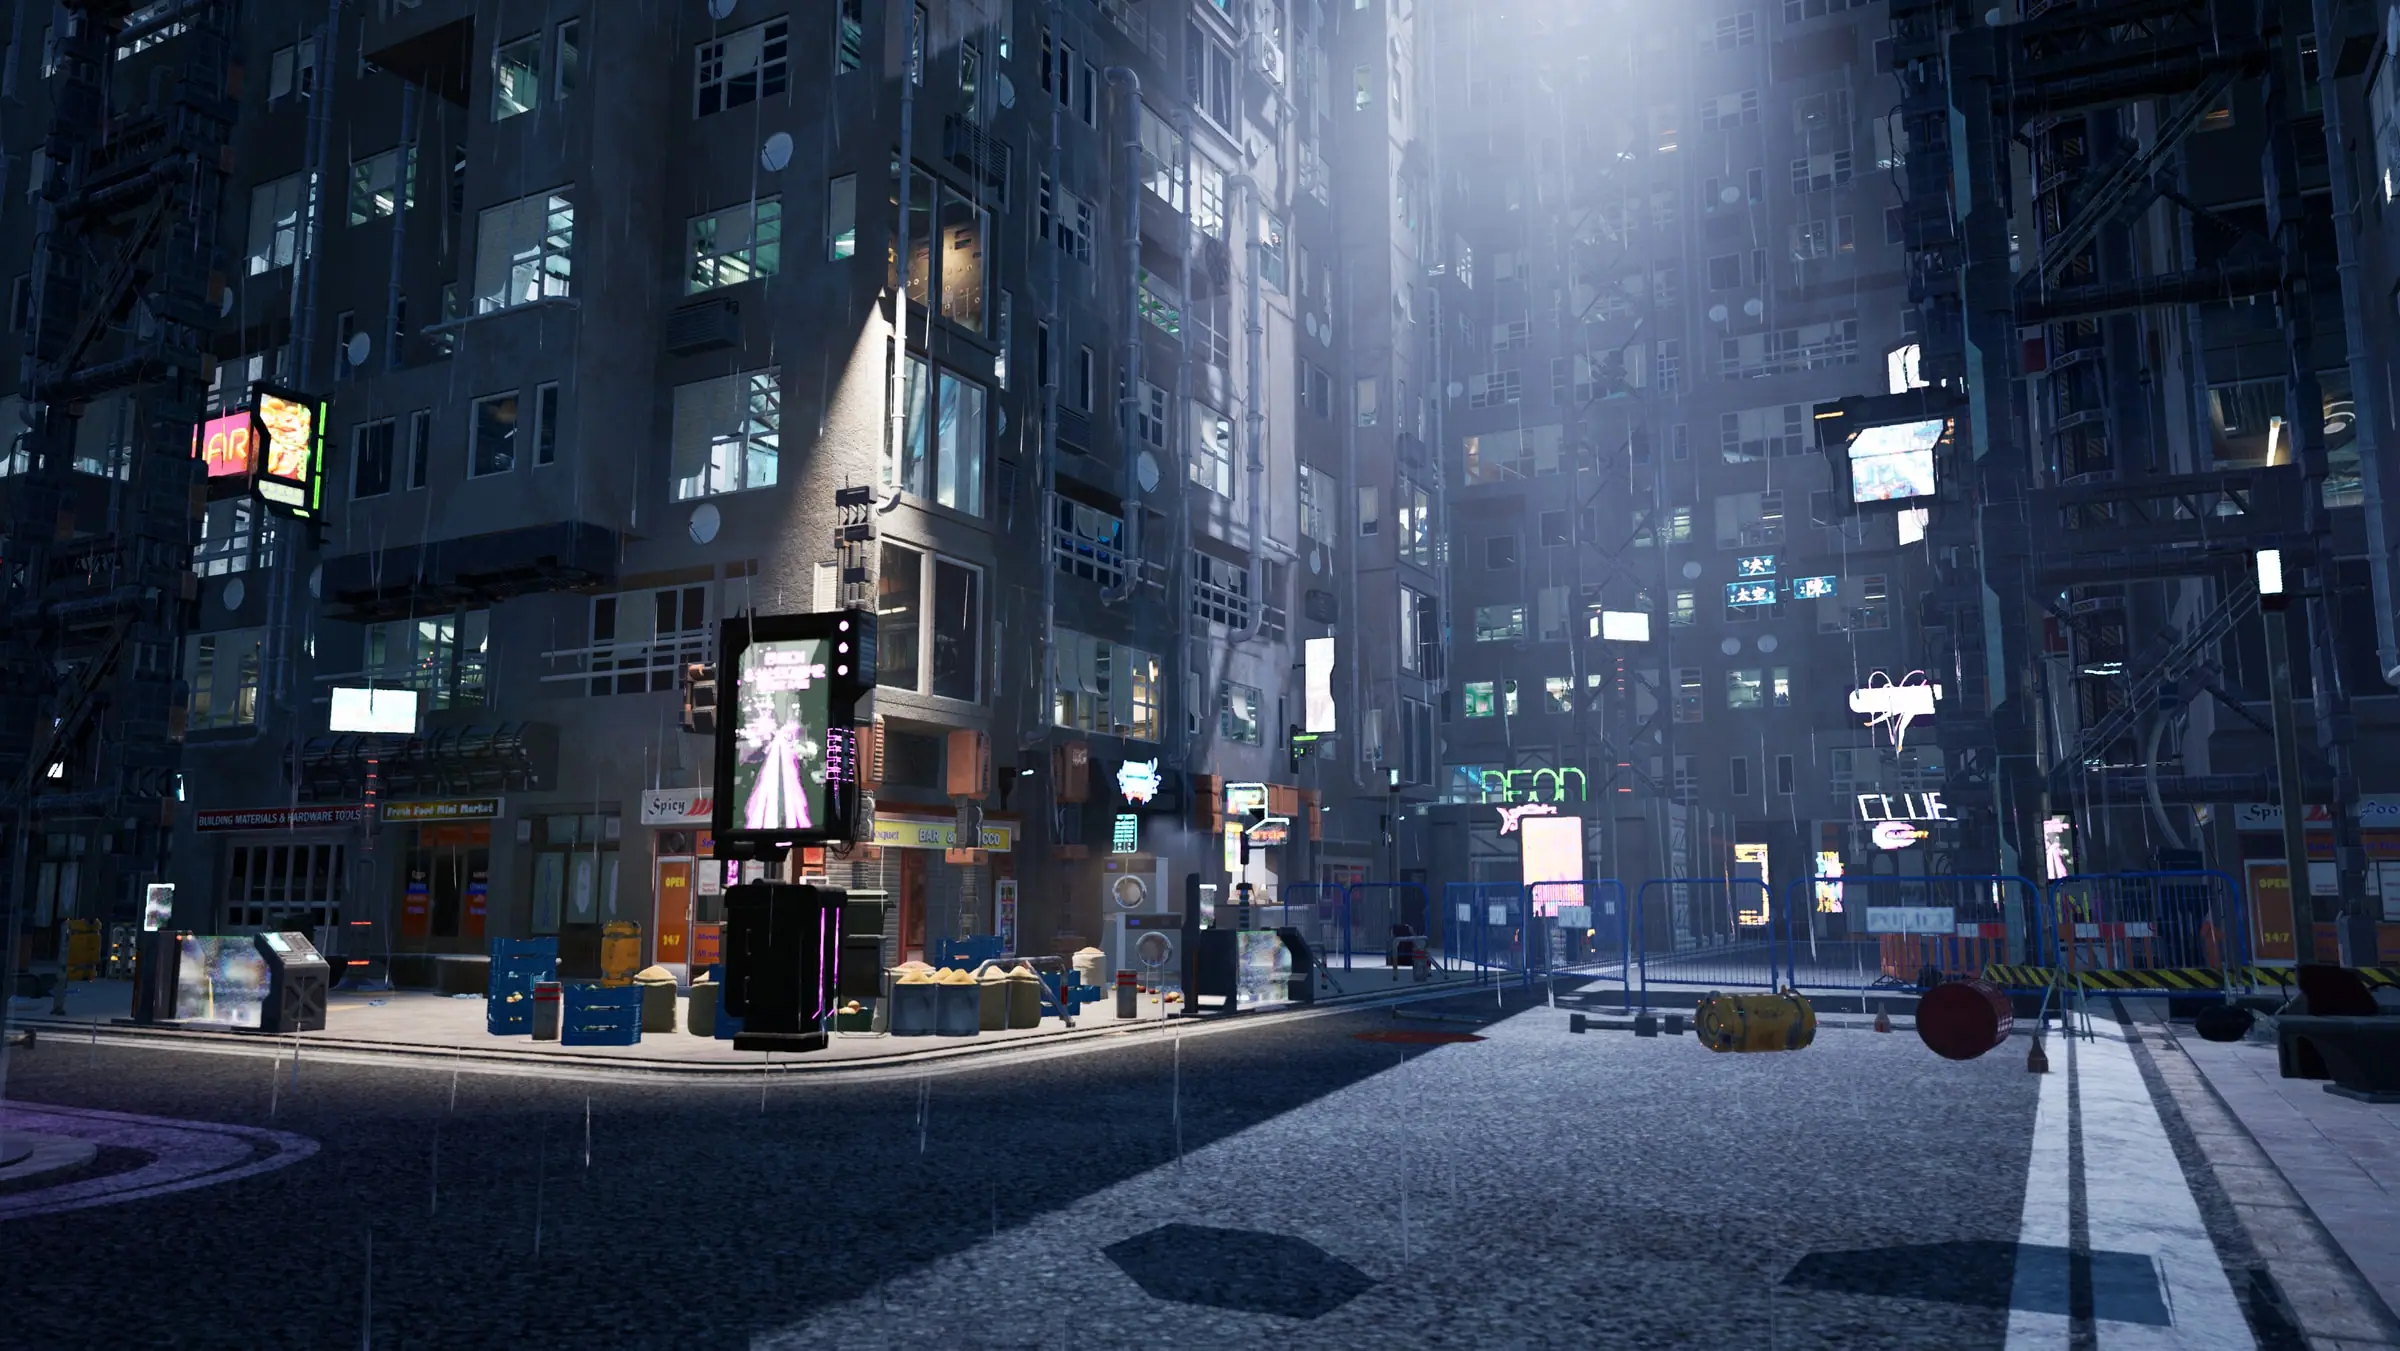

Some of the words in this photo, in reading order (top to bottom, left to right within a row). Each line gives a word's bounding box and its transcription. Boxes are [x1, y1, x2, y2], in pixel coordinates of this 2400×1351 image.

[387, 806, 411, 817] Fresh
[413, 805, 434, 816] Food
[437, 804, 457, 815] Mini
[460, 802, 494, 814] Market
[648, 797, 686, 815] Spicy
[198, 815, 233, 827] BUILDING
[235, 813, 278, 825] MATERIALS
[279, 812, 285, 824] &
[288, 811, 333, 824] HARDWARE
[335, 809, 361, 821] TOOLS
[919, 828, 940, 844] BAR
[947, 830, 956, 844] &
[665, 876, 686, 889] OPEN
